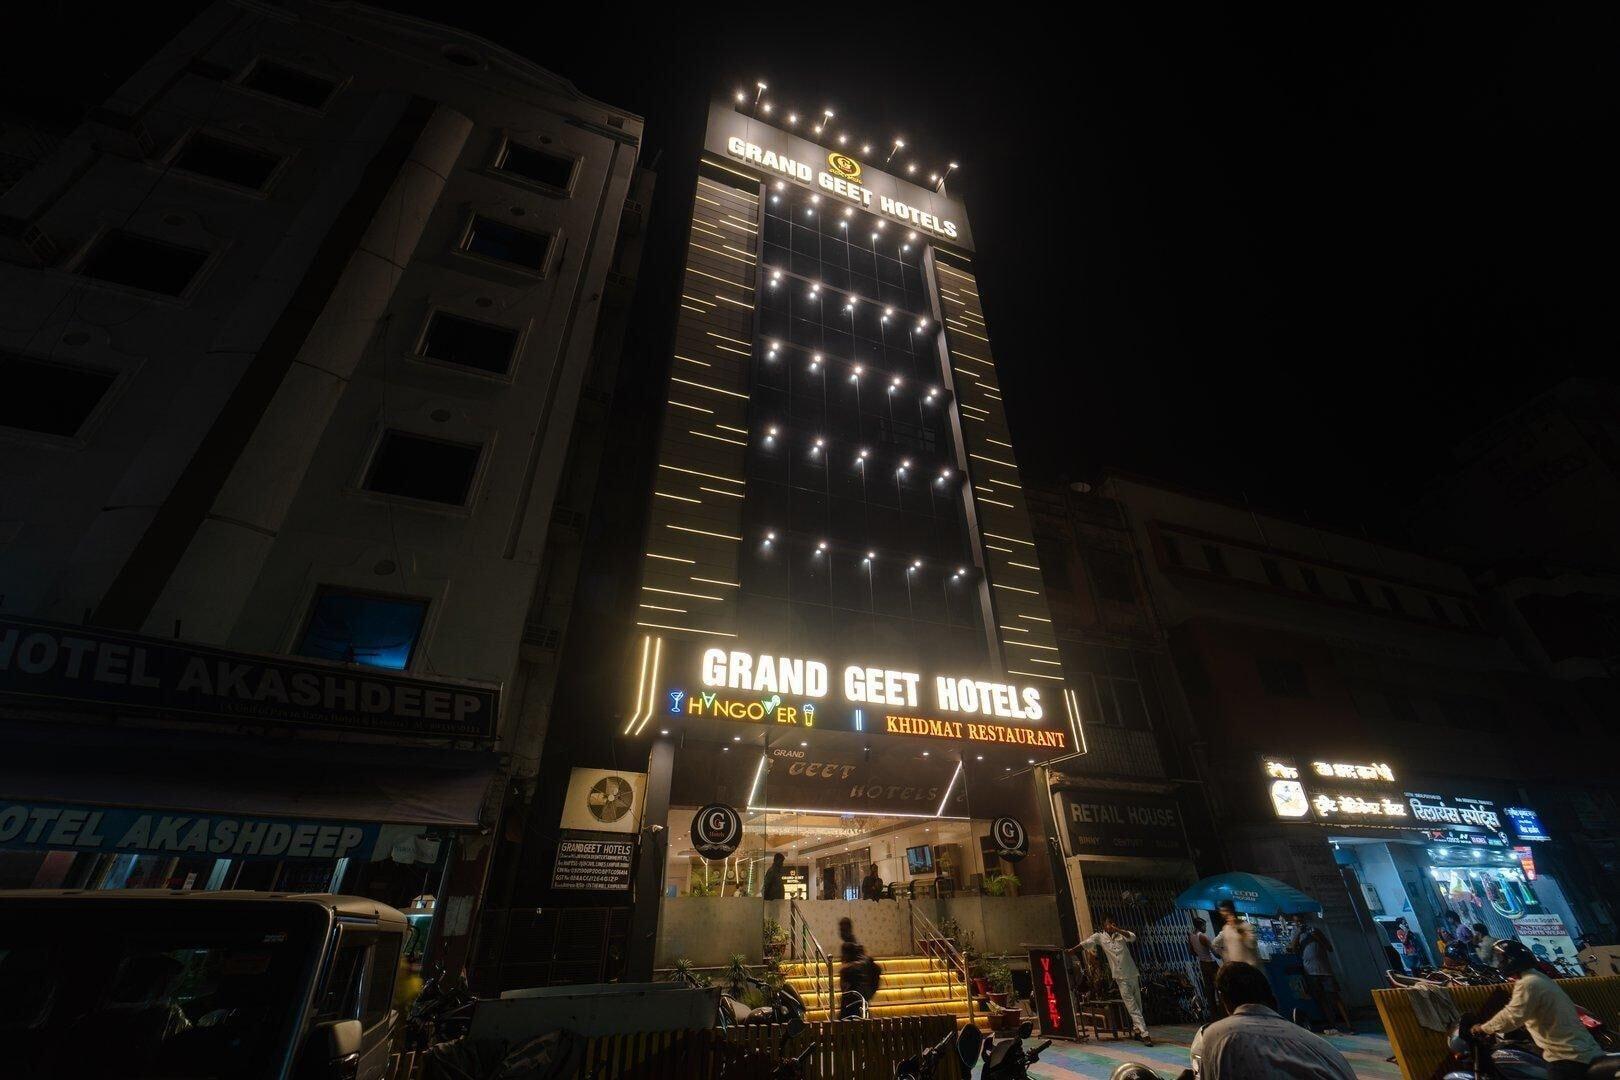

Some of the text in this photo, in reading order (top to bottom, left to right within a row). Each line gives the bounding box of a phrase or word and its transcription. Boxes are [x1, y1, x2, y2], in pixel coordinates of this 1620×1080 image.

[729, 136, 812, 182] GRAND
[819, 172, 873, 206] GEET
[881, 196, 958, 239] HOTELS
[175, 656, 483, 722] AKASHDEEP
[702, 648, 1042, 721] GRAND GEET HOTELS
[886, 715, 1066, 748] KHIDMAT RESTAURANT
[773, 748, 805, 759] GRAND
[788, 761, 857, 780] GEET
[849, 783, 939, 801] HOTELS
[1070, 803, 1177, 827] RETAIL HOUSE
[0, 806, 363, 858] OTEL AKASHDEEP
[603, 845, 632, 855] HOTELS
[1039, 955, 1061, 1029] VALET
